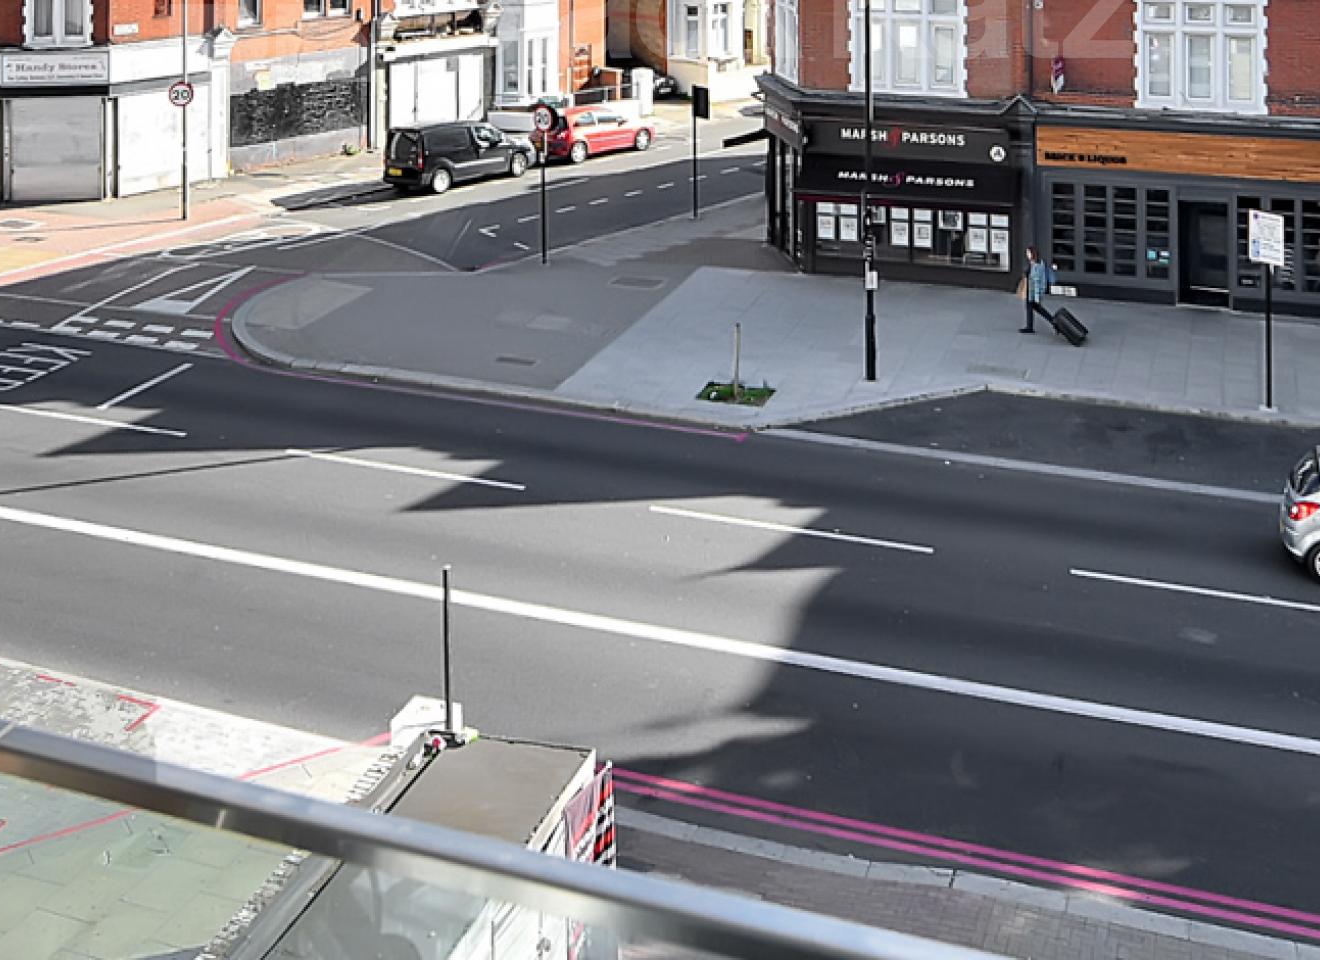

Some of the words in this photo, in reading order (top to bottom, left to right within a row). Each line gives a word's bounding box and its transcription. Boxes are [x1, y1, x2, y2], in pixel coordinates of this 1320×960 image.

[15, 63, 55, 73] Handy
[57, 62, 97, 71] Stores
[172, 89, 190, 101] 20
[901, 131, 966, 147] PARSONS
[905, 174, 975, 188] PARSONS
